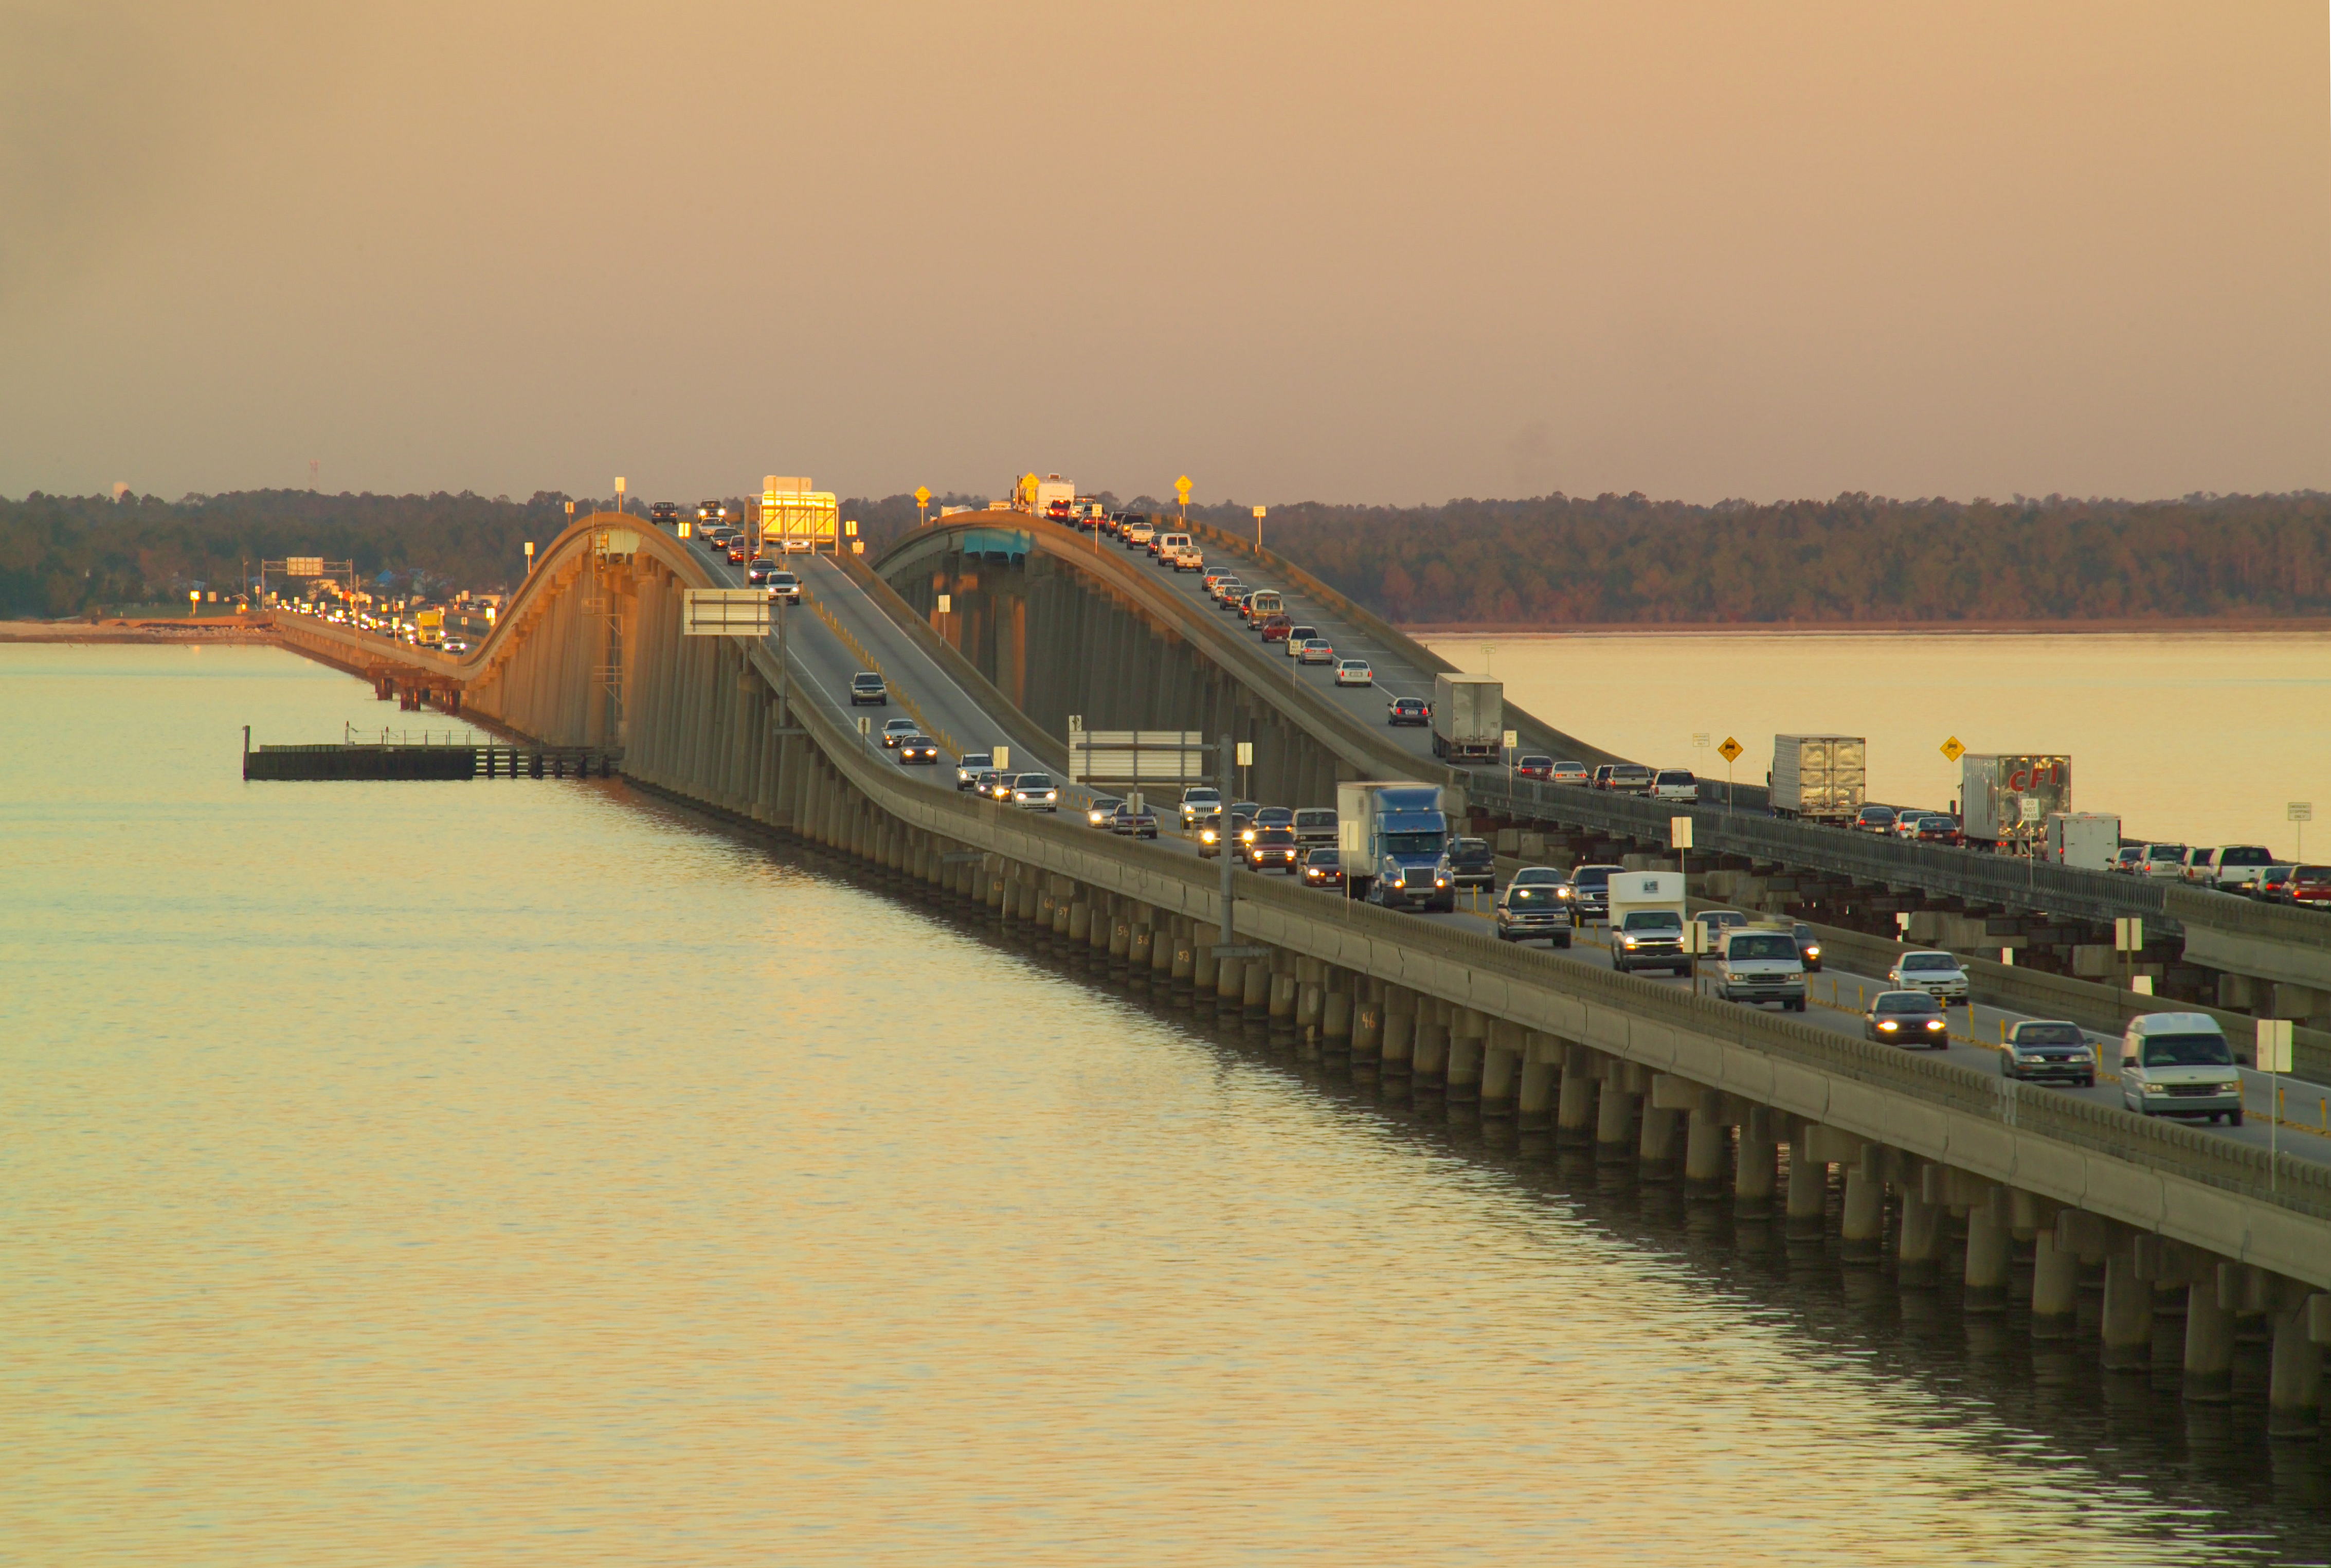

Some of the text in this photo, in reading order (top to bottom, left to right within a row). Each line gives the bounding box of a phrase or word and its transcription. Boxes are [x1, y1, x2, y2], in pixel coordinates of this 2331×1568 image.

[2009, 763, 2058, 793] CFI
[1118, 926, 1129, 936] 56
[1178, 950, 1189, 962] 53
[1362, 1011, 1376, 1029] 46
